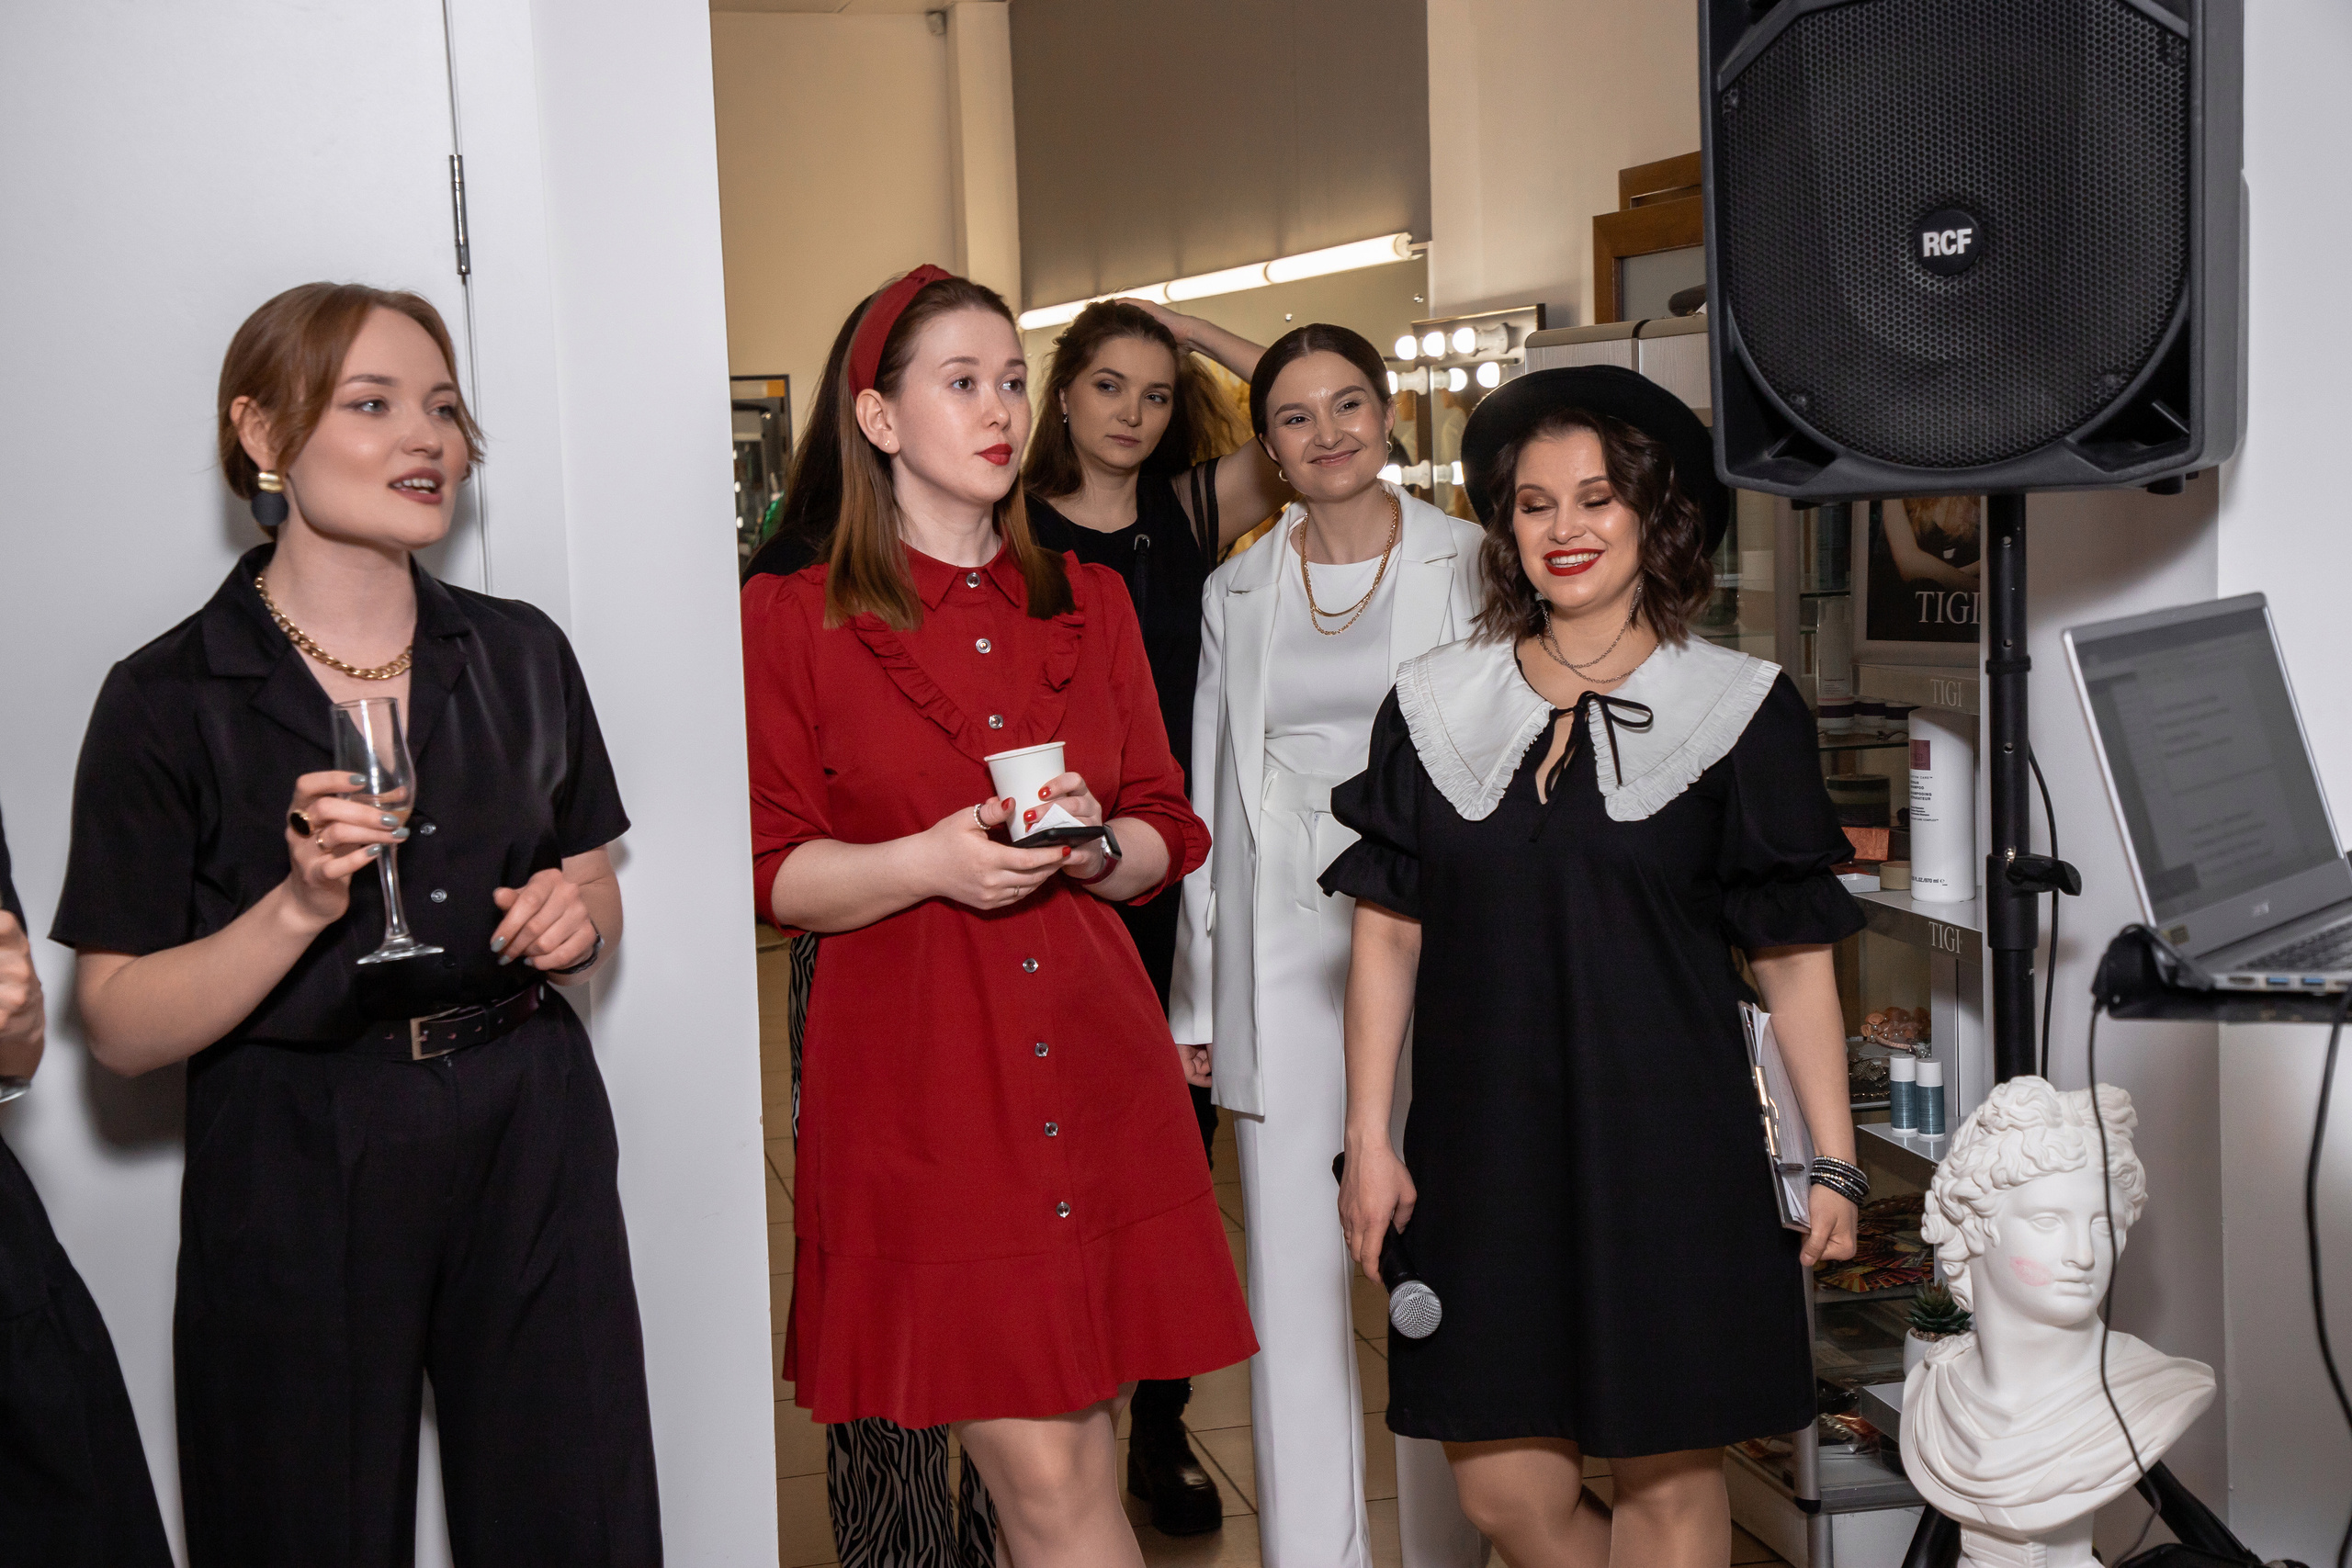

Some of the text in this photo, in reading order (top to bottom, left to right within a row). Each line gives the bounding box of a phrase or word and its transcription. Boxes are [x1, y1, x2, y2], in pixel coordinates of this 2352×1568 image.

[1923, 228, 1973, 257] RCF
[1915, 591, 1981, 624] TIGI
[1929, 679, 1962, 707] TIGI
[1928, 921, 1962, 954] TIGI
